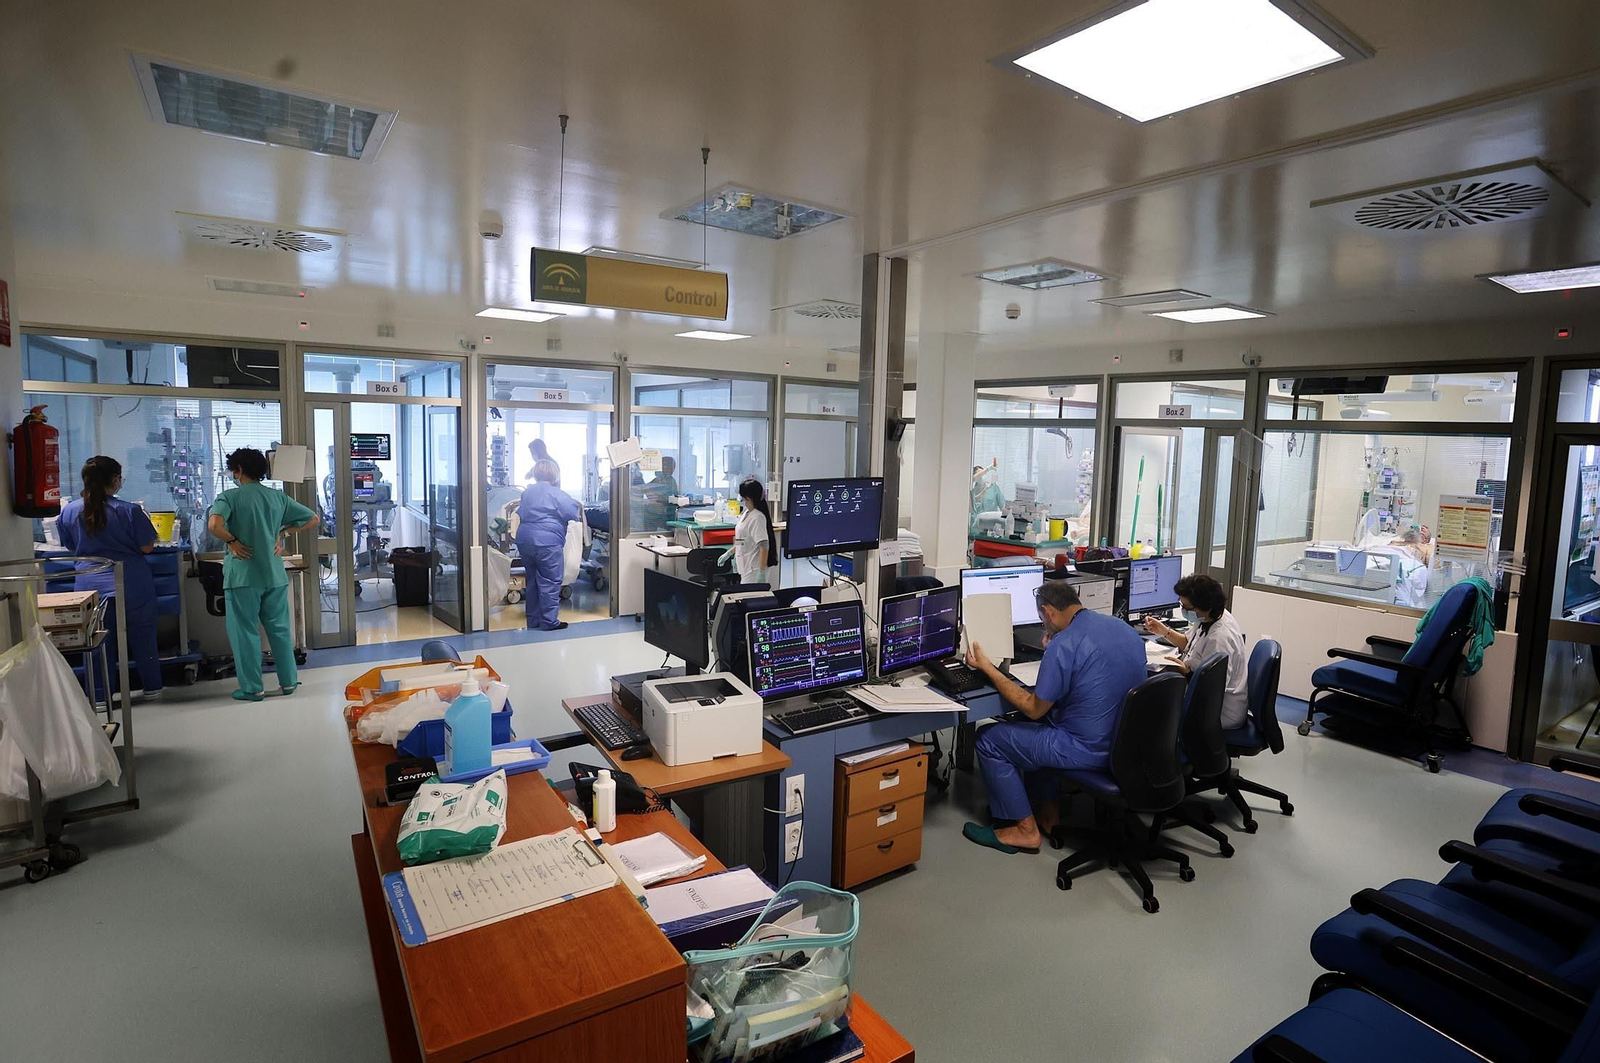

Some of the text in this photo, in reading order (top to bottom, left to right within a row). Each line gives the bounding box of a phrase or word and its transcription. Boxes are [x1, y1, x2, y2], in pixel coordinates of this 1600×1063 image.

[664, 285, 718, 307] Control
[375, 384, 398, 393] Box 6
[544, 392, 563, 400] Box 5
[1165, 407, 1185, 416] Box 2
[815, 635, 826, 643] 100
[761, 644, 770, 652] 98
[397, 771, 437, 782] CONTROL
